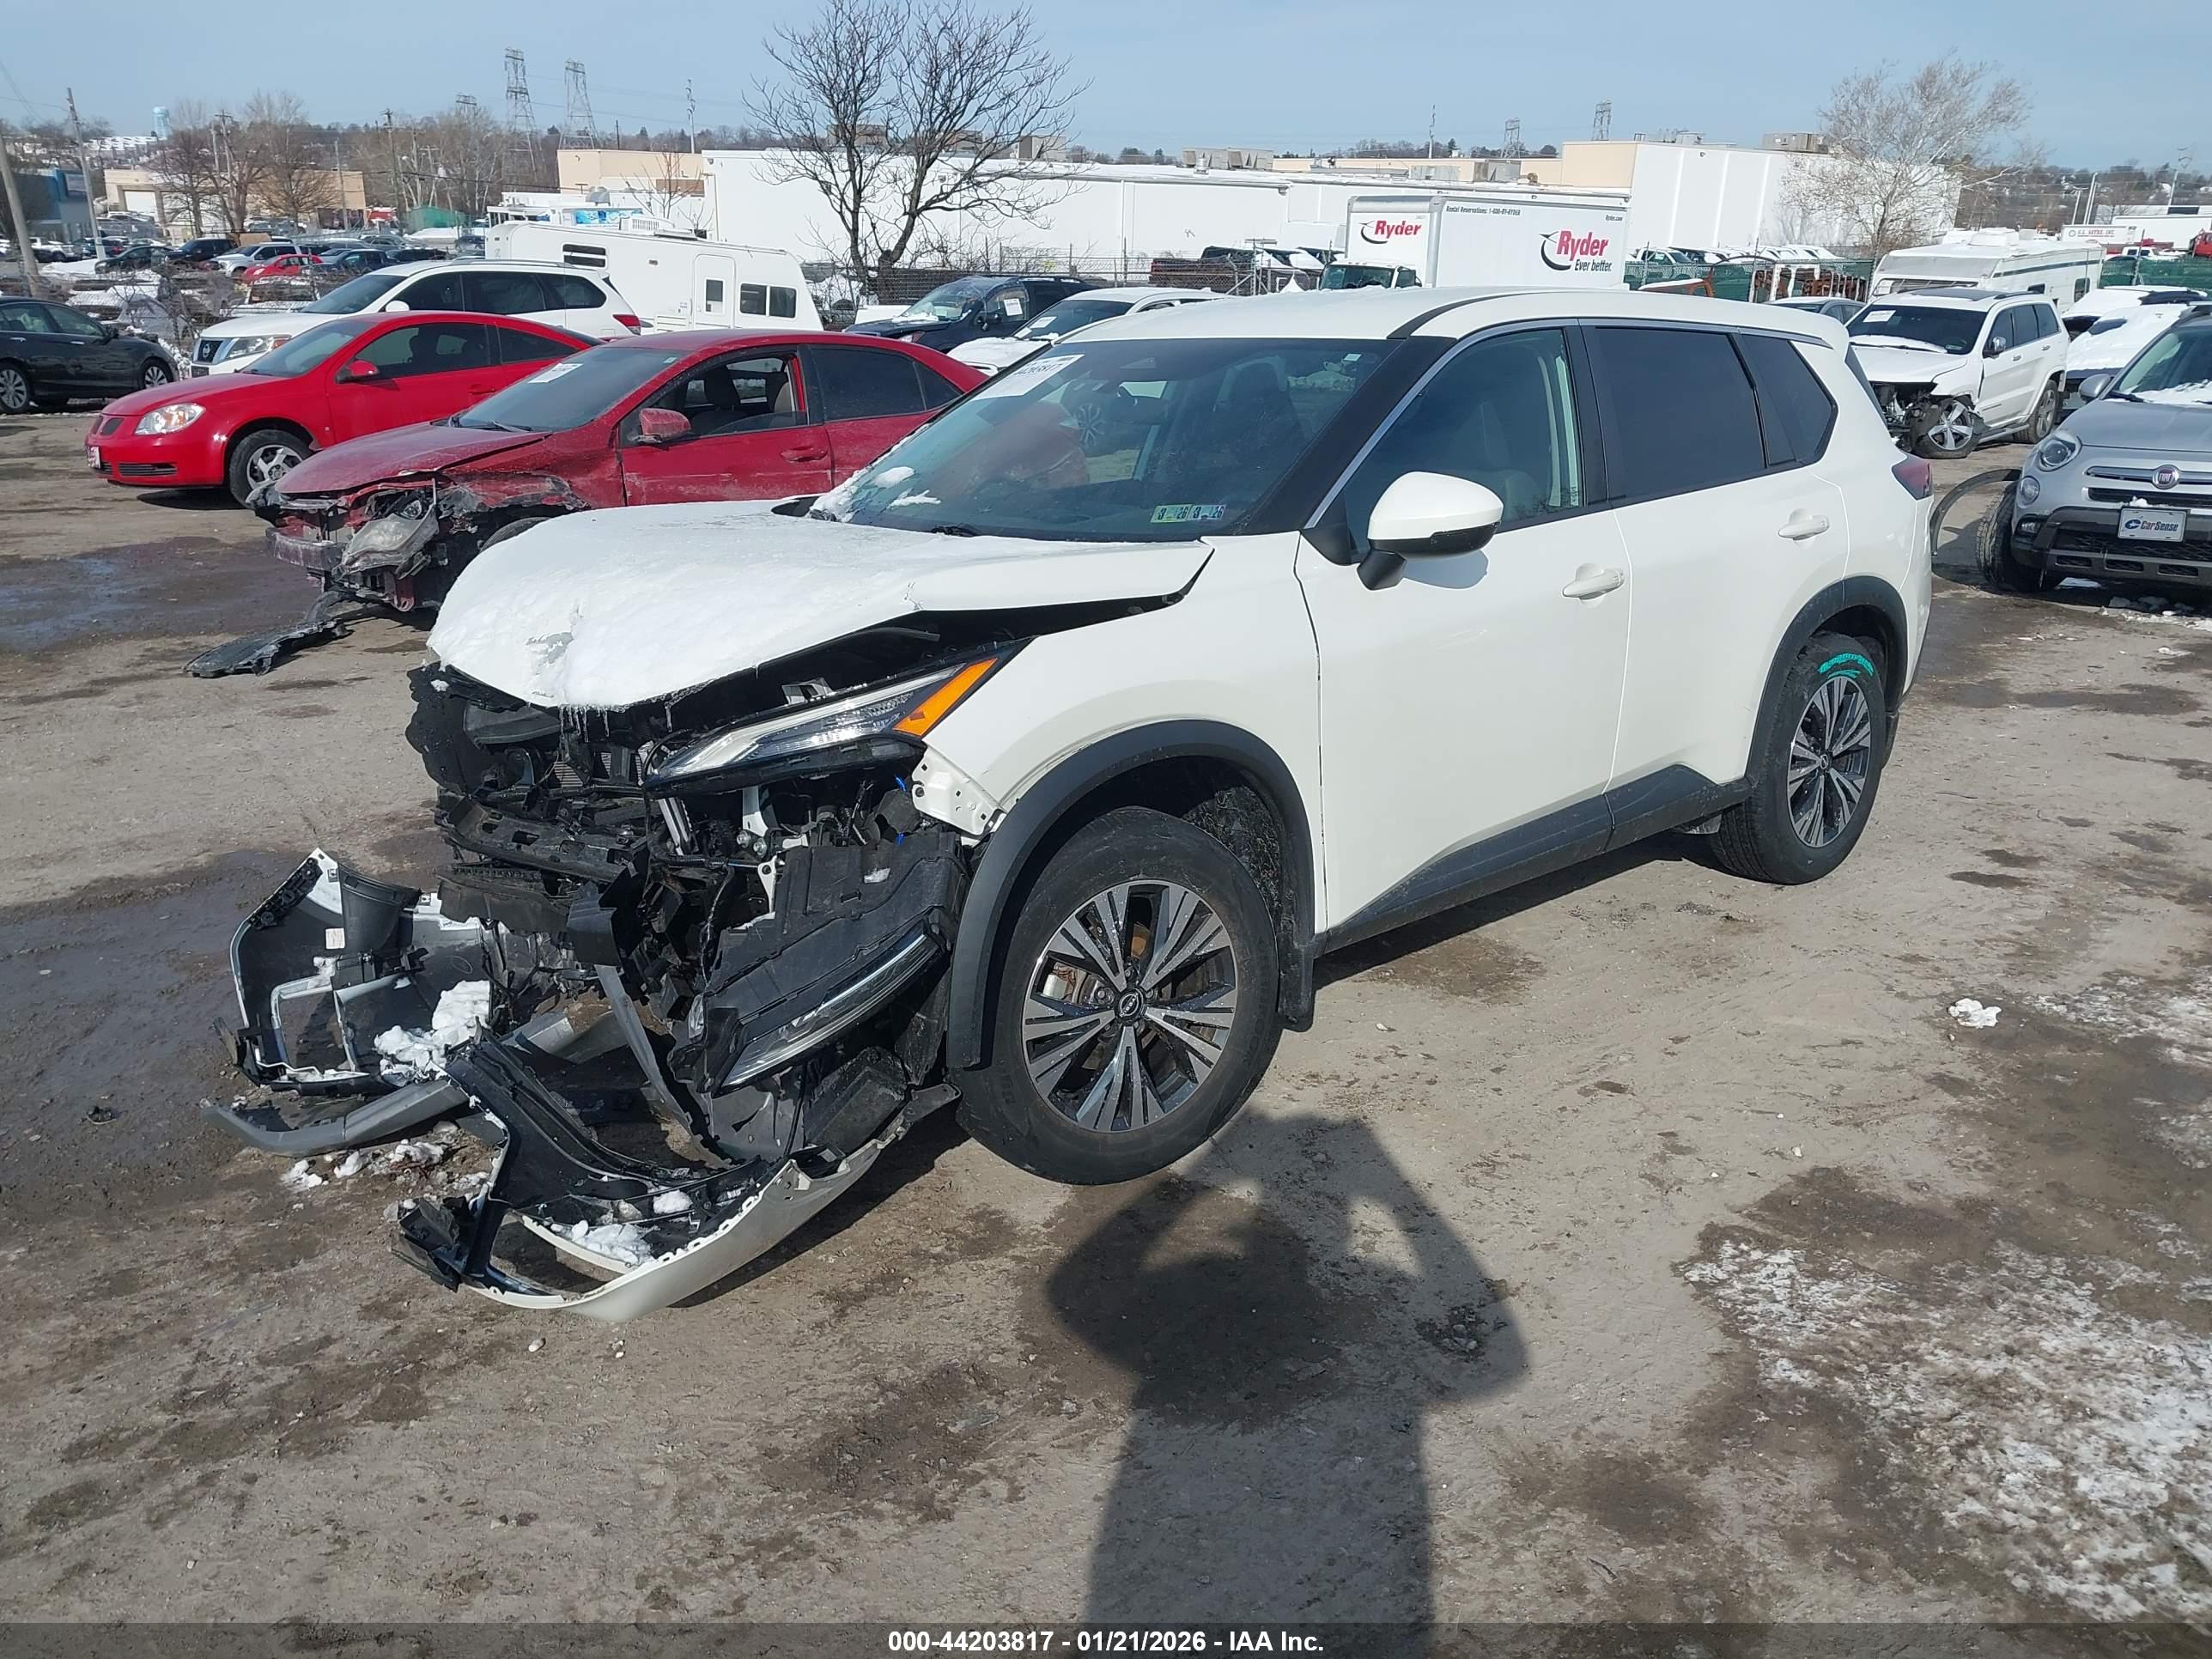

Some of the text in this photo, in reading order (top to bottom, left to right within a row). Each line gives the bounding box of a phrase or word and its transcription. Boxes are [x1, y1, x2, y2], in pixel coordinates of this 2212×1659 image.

[1374, 219, 1422, 239] Ryder
[1556, 230, 1609, 261] Ryder
[1574, 258, 1613, 271] Ever better.
[2141, 520, 2179, 532] CarSense
